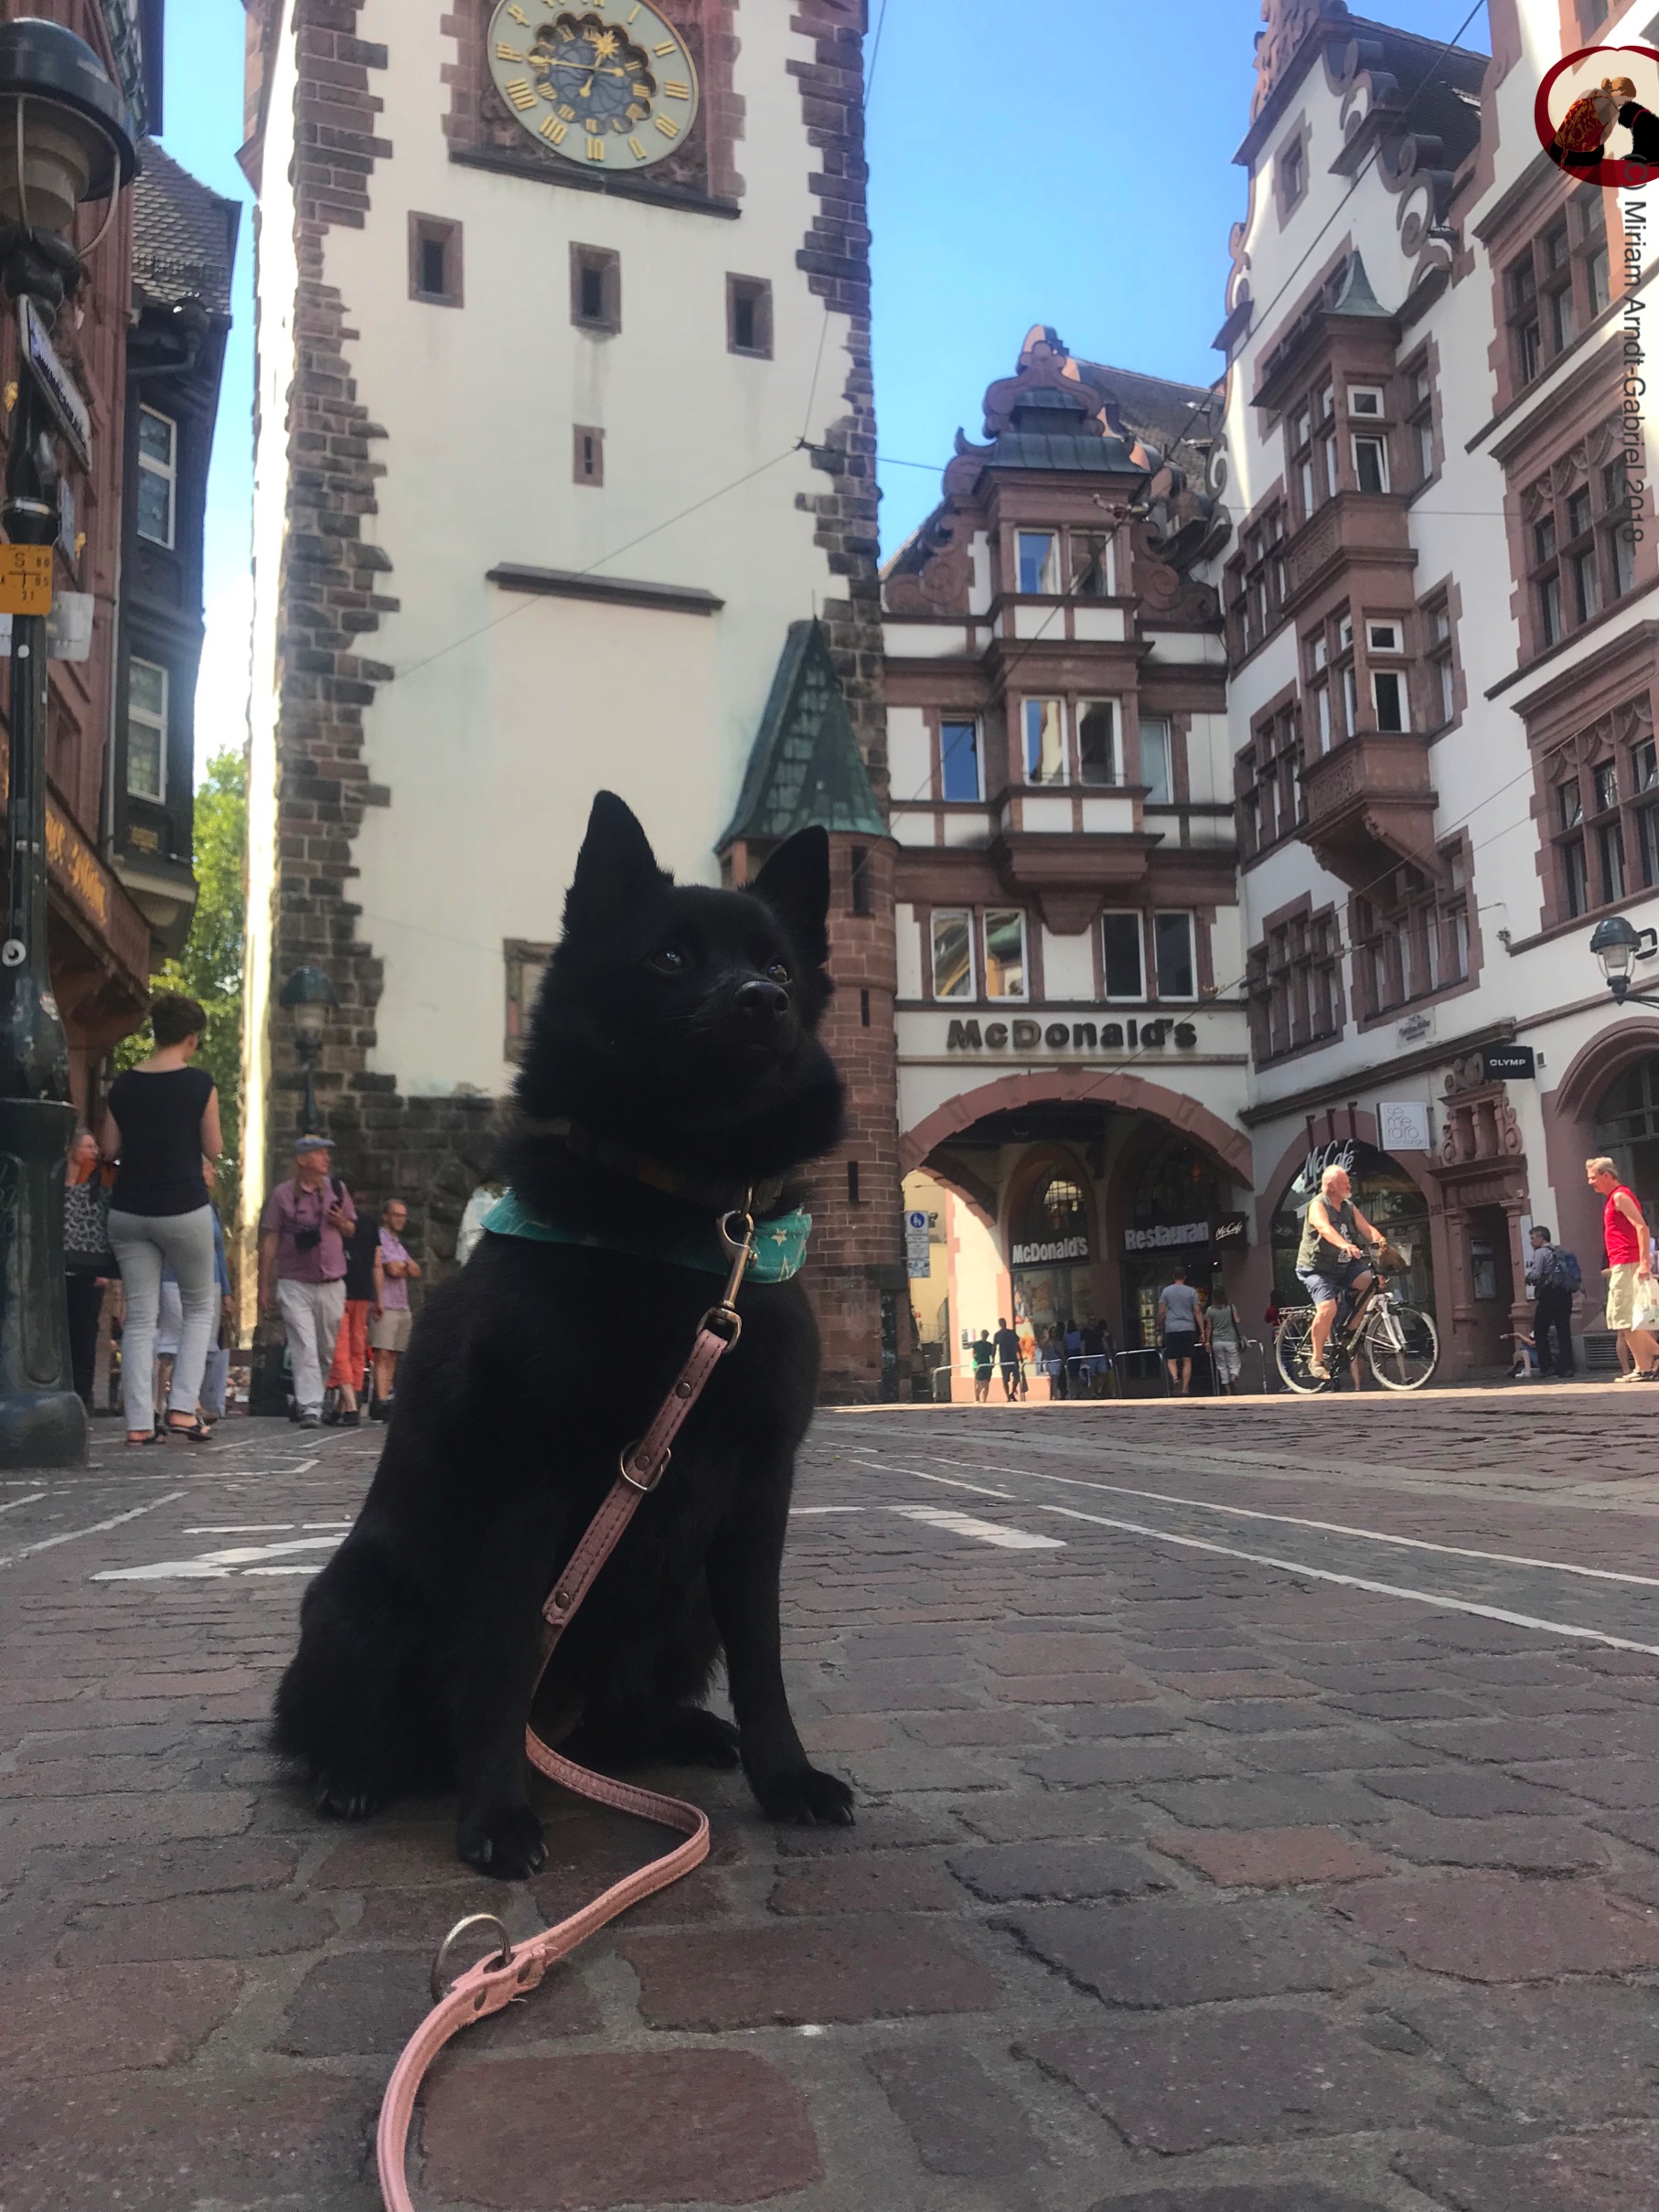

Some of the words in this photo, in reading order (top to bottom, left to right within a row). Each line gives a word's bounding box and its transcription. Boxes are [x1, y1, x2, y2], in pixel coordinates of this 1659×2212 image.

[15, 551, 26, 568] S
[947, 1018, 1197, 1049] McDonald's
[1489, 1058, 1526, 1067] OLYMP
[1011, 1236, 1089, 1265] McDonald's
[1124, 1222, 1210, 1251] Restauran
